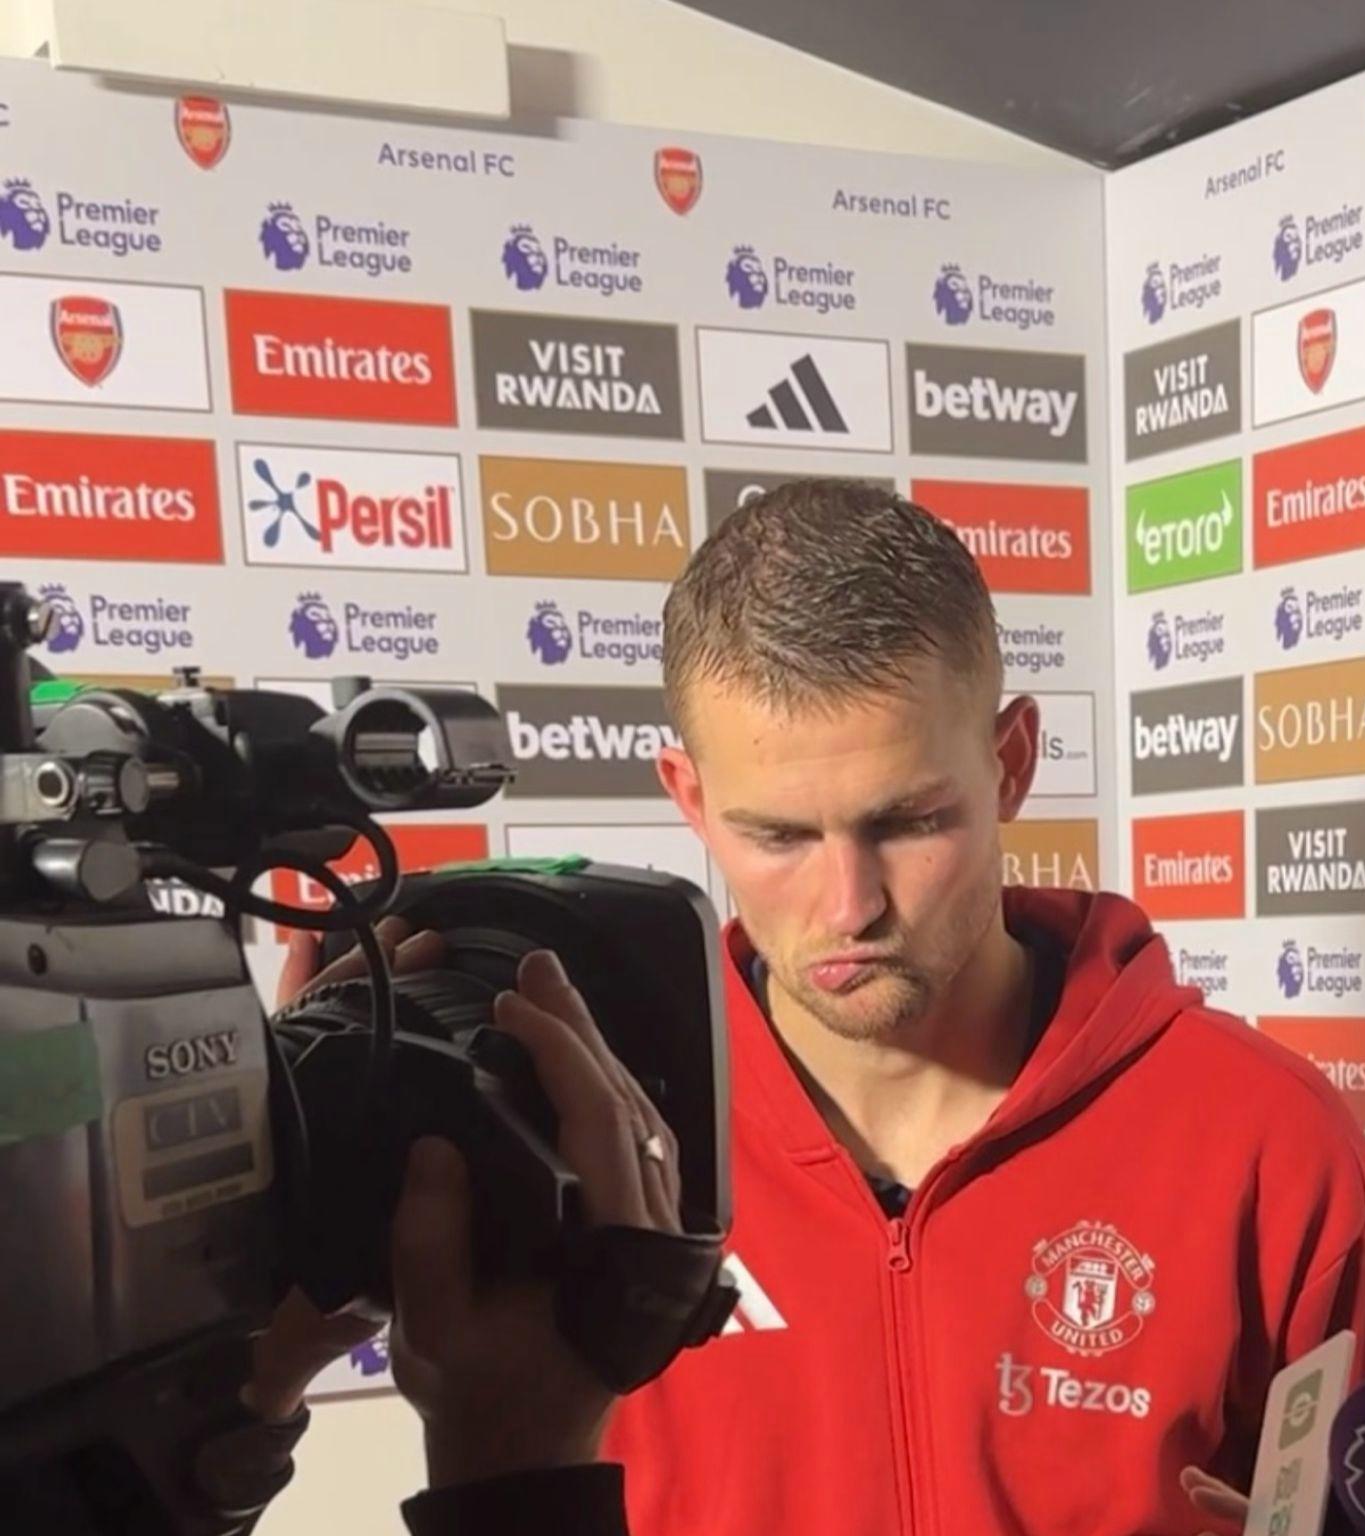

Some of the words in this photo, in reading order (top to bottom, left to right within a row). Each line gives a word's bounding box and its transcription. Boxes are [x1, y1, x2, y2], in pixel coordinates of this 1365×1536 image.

[378, 143, 476, 174] Arsenal
[484, 155, 516, 177] FC
[1205, 155, 1262, 199] Arsenal
[1267, 149, 1285, 172] FC
[57, 191, 159, 225] Premier
[832, 188, 917, 218] Arsenal
[921, 197, 951, 221] FC
[316, 215, 410, 248] Premier
[1305, 205, 1363, 238] Premier
[59, 220, 162, 257] League
[553, 236, 641, 269] Premier
[1305, 231, 1363, 265] League
[317, 242, 412, 276] League
[774, 256, 856, 288] Premier
[1169, 254, 1221, 284] Premier
[555, 263, 643, 294] League
[978, 275, 1055, 306] Premier
[1169, 278, 1222, 311] League
[775, 283, 857, 314] League
[979, 300, 1056, 330] League
[253, 334, 433, 386] Emirates
[529, 338, 624, 378] VISIT
[1153, 354, 1208, 395] VISIT
[496, 372, 661, 415] RWANDA
[915, 370, 1078, 437] betway
[1135, 391, 1229, 436] RWANDA
[2, 473, 196, 523] Emirates
[317, 480, 452, 552] Persil
[490, 493, 685, 548] SOBHA
[957, 520, 1072, 560] mirates
[90, 595, 191, 624] Premier
[1306, 586, 1362, 613] Premier
[344, 603, 437, 630] Premier
[578, 609, 663, 638] Premier
[1175, 612, 1224, 635] Premier
[1306, 611, 1362, 643] League
[92, 620, 194, 654] League
[346, 628, 439, 659] League
[579, 635, 664, 664] League
[1175, 634, 1224, 662] League
[1134, 713, 1239, 768] betway
[1287, 828, 1347, 860] VISIT
[1143, 851, 1232, 888] Emirates
[1180, 950, 1228, 971] Premier
[1307, 946, 1362, 972] Premier
[1307, 969, 1362, 999] League
[147, 1030, 239, 1080] SONY
[1042, 1230, 1145, 1281] MANCHESTER
[1050, 1319, 1124, 1348] UNITED
[1040, 1366, 1152, 1419] Tezos
